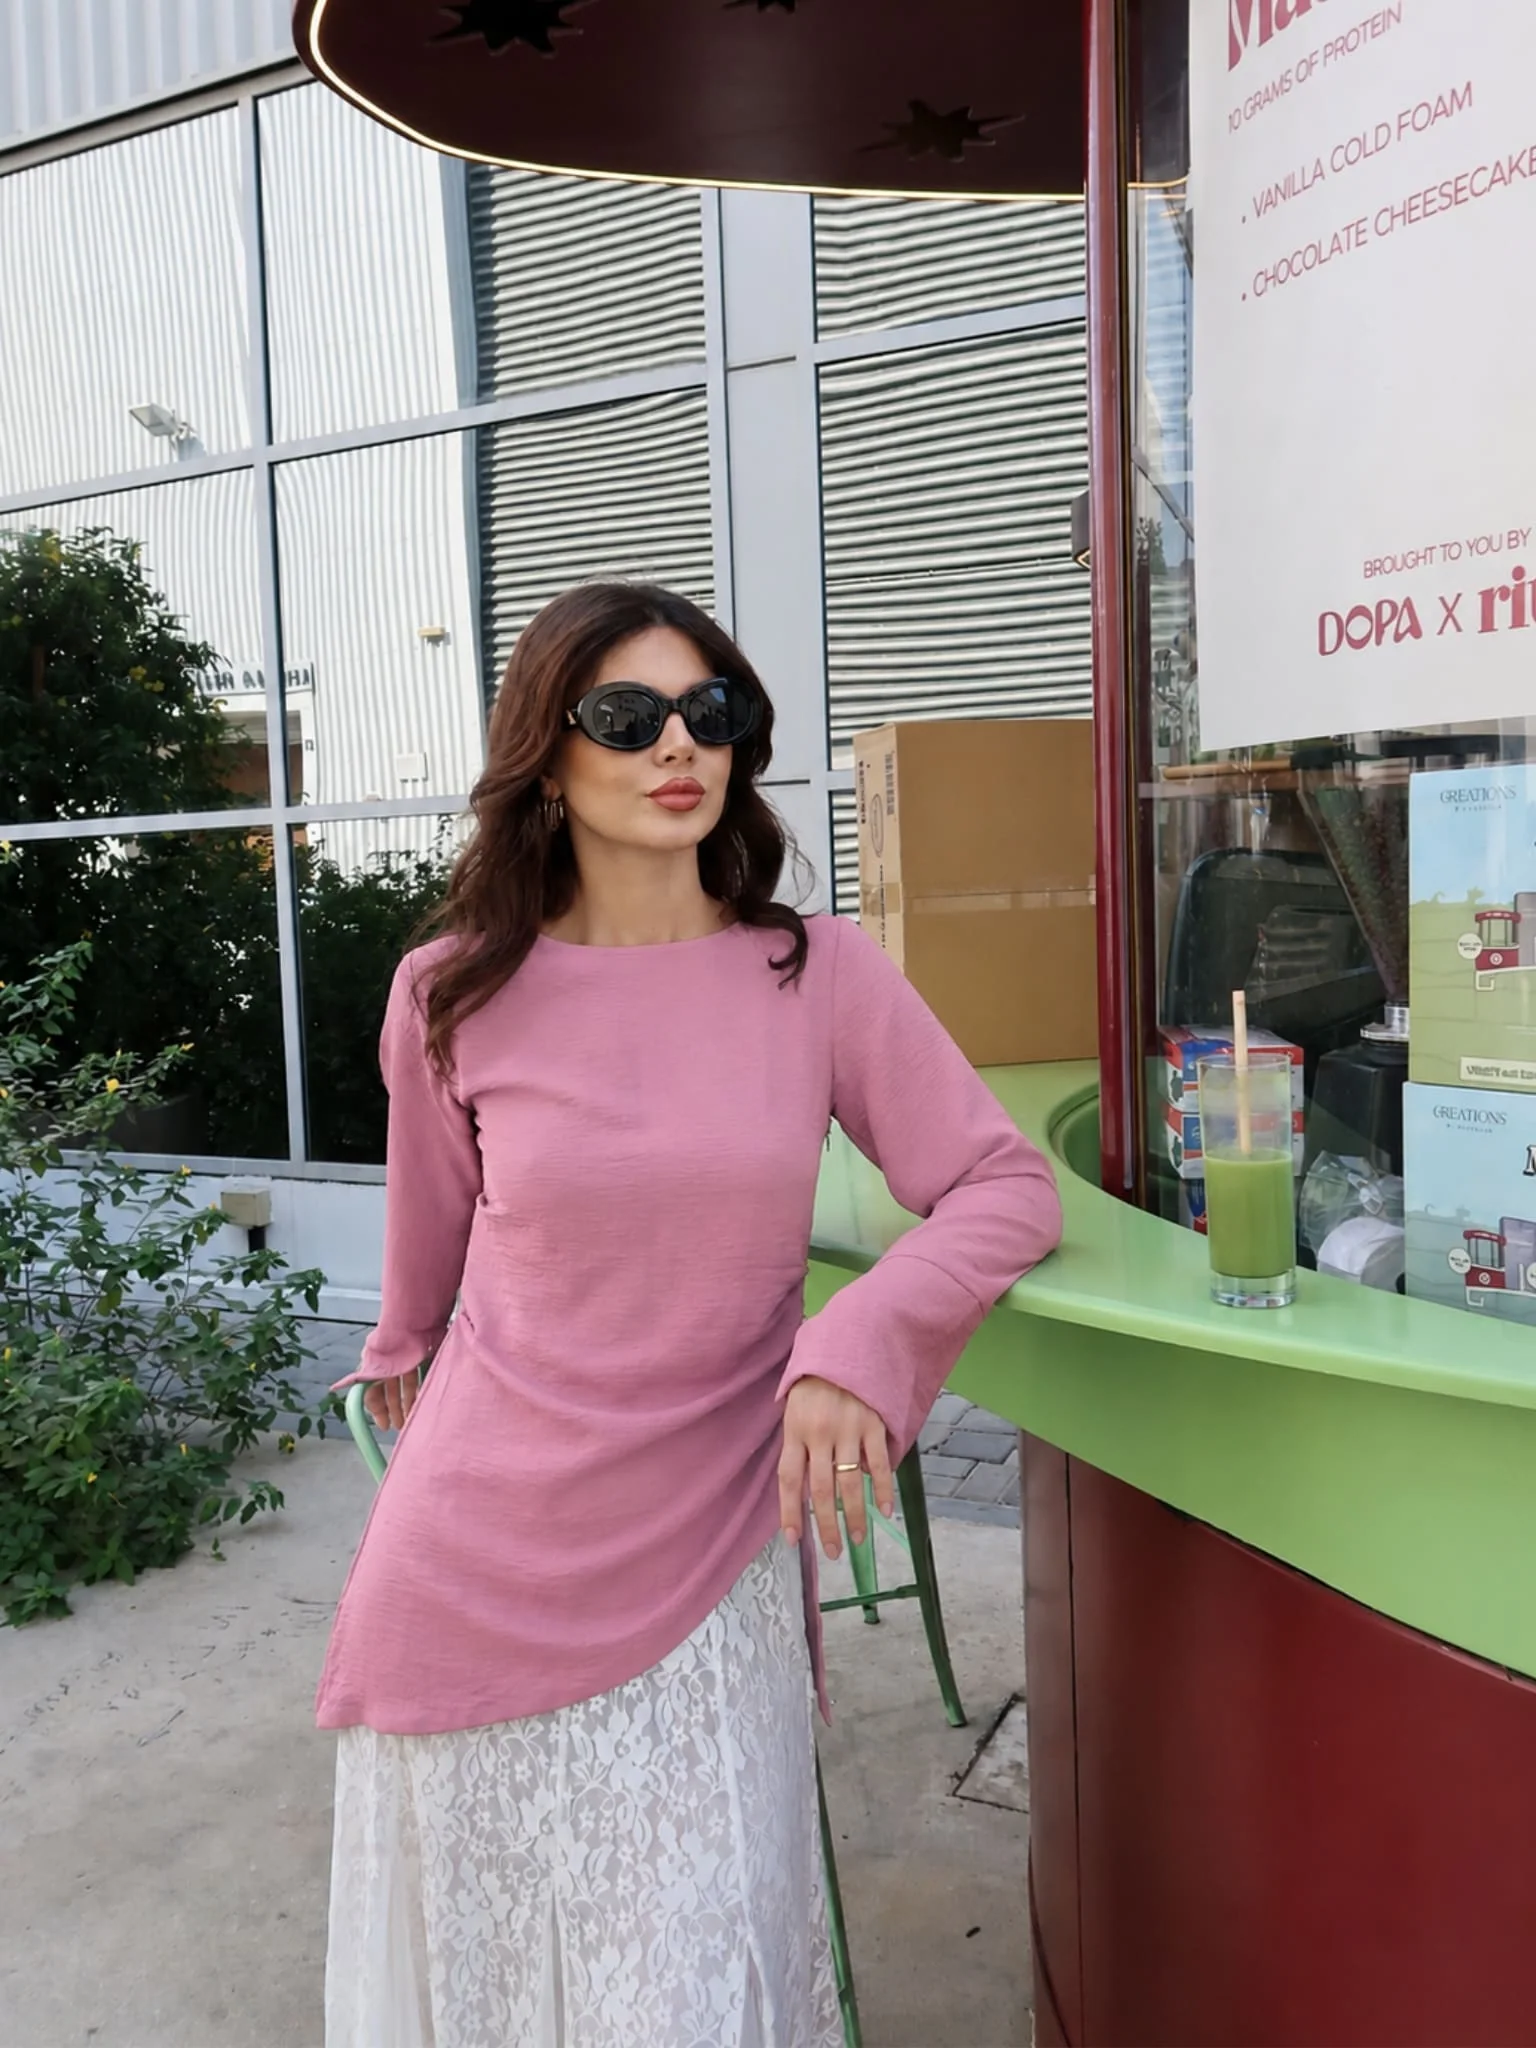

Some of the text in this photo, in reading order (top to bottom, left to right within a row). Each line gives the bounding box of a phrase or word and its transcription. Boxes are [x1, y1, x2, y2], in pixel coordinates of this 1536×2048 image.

[1228, 2, 1402, 134] 10 GRAMS OF PROTEIN
[1252, 81, 1473, 218] VANILLA COLD FOAM
[1253, 217, 1369, 297] CHOCOLATE
[1363, 527, 1531, 579] BROUGHT TO YOU BY
[1318, 596, 1423, 657] DOPA
